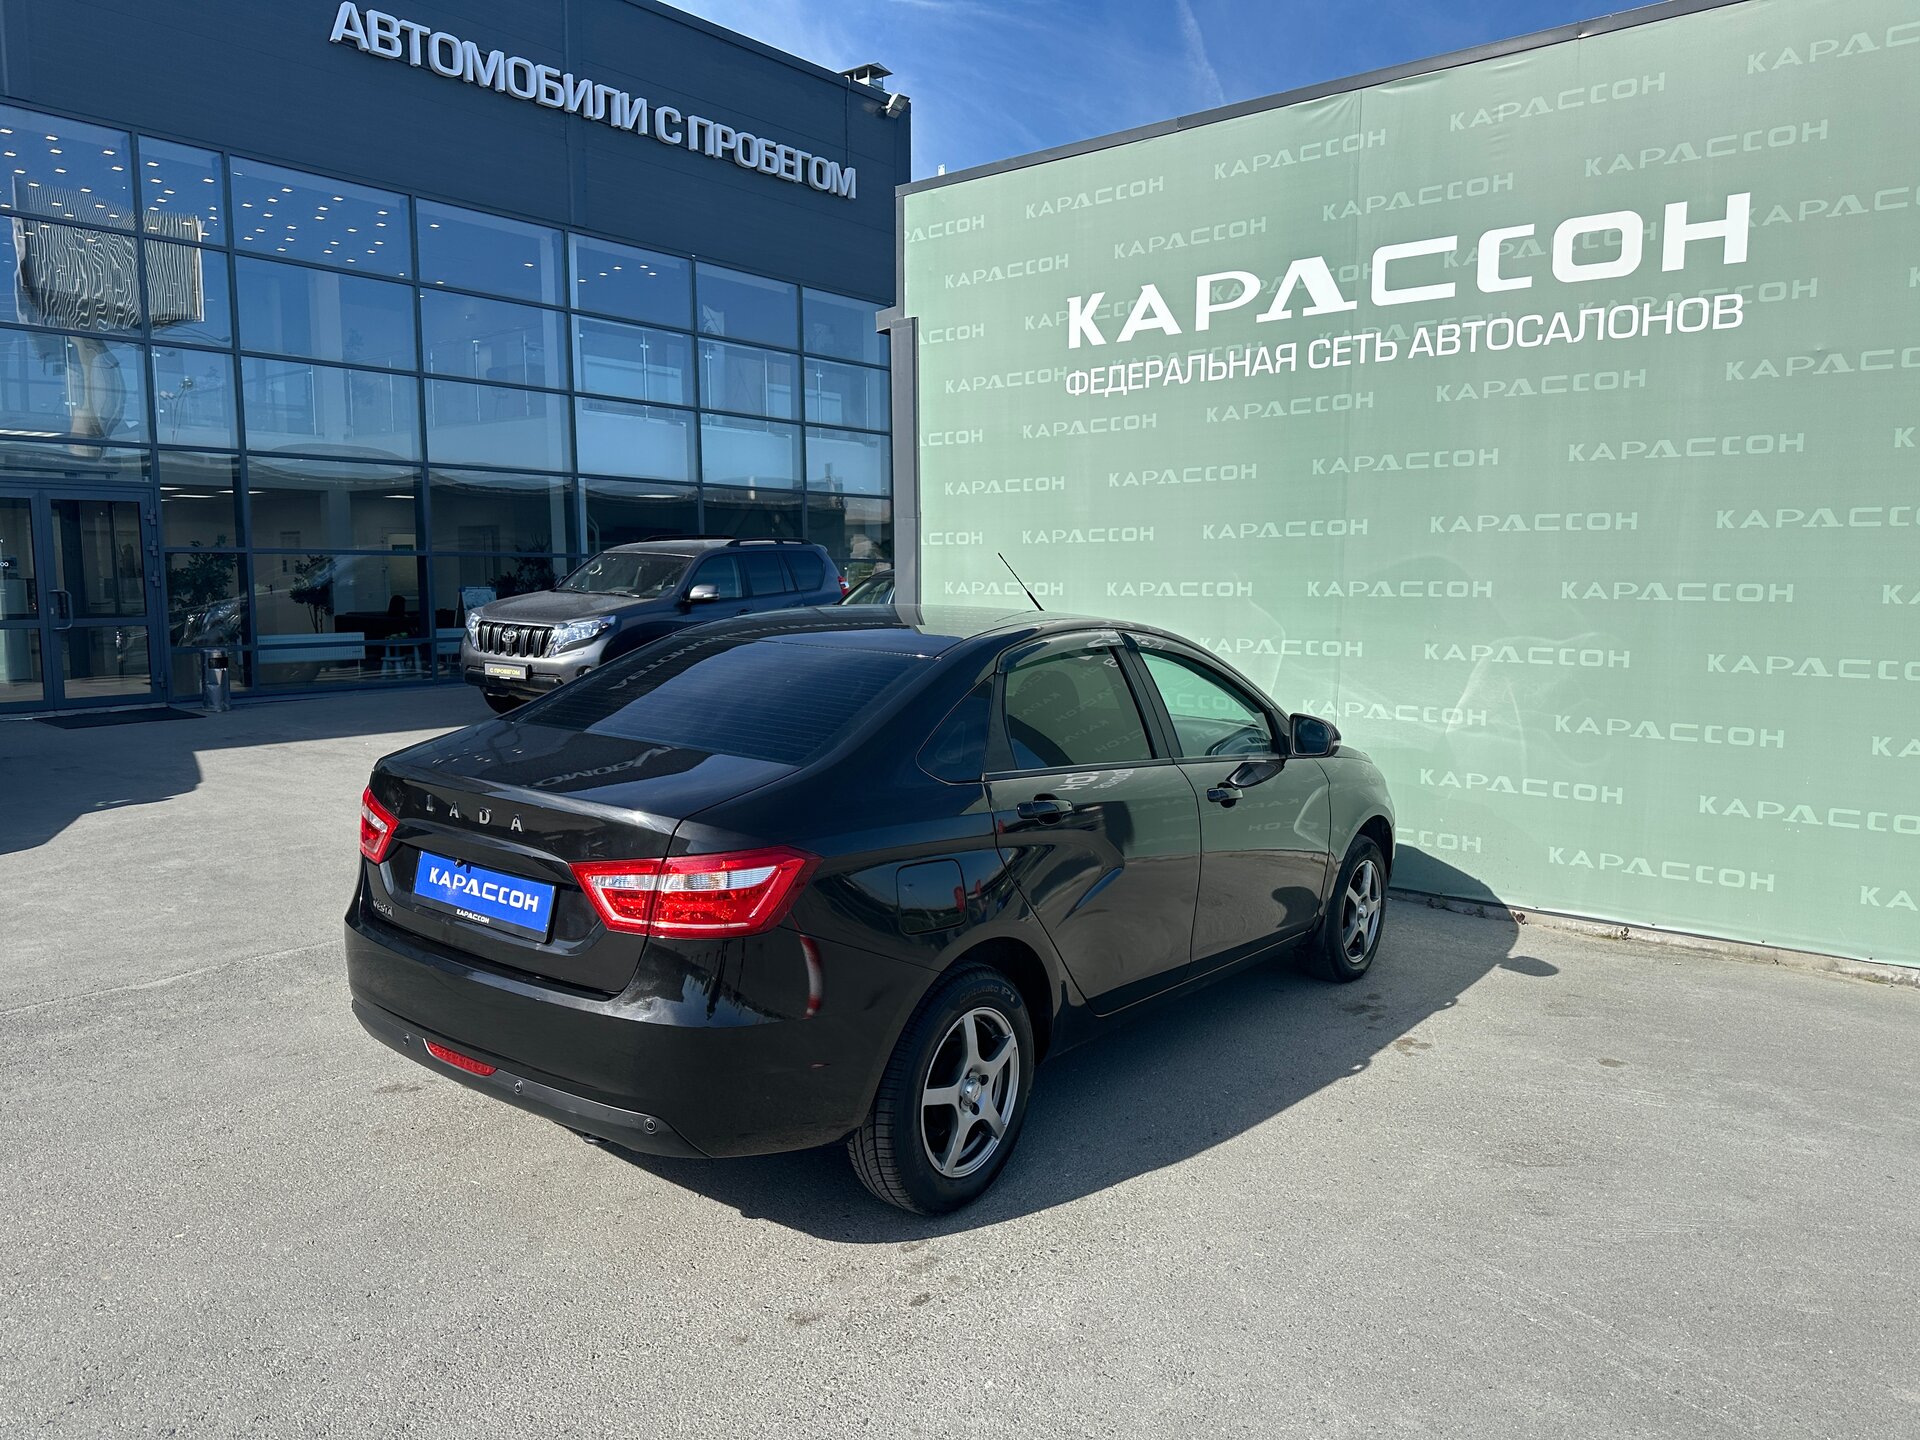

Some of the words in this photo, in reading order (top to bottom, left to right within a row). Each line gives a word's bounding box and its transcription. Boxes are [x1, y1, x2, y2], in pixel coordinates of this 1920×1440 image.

[329, 1, 648, 136] АВТОМОБИЛИ
[655, 105, 682, 146] С
[686, 115, 857, 200] ПРОБЕГОМ
[1448, 72, 1666, 132] КАРАССОН
[1214, 128, 1387, 180] КАРАССОН
[1585, 119, 1828, 177] КАРАССОН
[1025, 175, 1164, 220] КАРАССОН
[1322, 172, 1514, 222] КАРАССОН
[1114, 216, 1267, 260] КАРАССОН
[945, 253, 1069, 289] КАРАССОН
[1066, 192, 1751, 350] КАРАССОН
[1066, 343, 1297, 398] ФЕДЕРАЛЬНАЯ
[1308, 333, 1398, 369] СЕТЬ
[1408, 294, 1744, 359] АВТОСАЛОНОВ
[945, 366, 1067, 395] КАРАССОН
[1436, 369, 1646, 402] КАРАССОН
[1206, 391, 1374, 423] КАРАССОН
[1022, 413, 1157, 439] КАРАССОН
[1312, 448, 1499, 476] КАРАССОН
[1568, 433, 1804, 462] КАРАССОН
[945, 476, 1065, 496] КАРАССОН
[1108, 463, 1257, 488] КАРАССОН
[1022, 527, 1155, 545] КАРАССОН
[1203, 519, 1368, 540] КАРАССОН
[1430, 512, 1638, 533] КАРАССОН
[945, 581, 1064, 596] КАРАССОН
[1107, 581, 1253, 597] КАРАССОН
[1307, 581, 1493, 598] КАРАССОН
[1561, 581, 1794, 602] КАРАССОН
[1424, 643, 1630, 669] КАРАССОН
[1302, 700, 1487, 727] КАРАССОН
[1554, 715, 1784, 749] КАРАССОН
[1420, 768, 1623, 805] КАРАССОН
[426, 793, 524, 833] LADA
[1549, 846, 1774, 893] КАРАССОН
[429, 866, 540, 913] КАРАССОН
[456, 908, 490, 924] КАРАССОН
